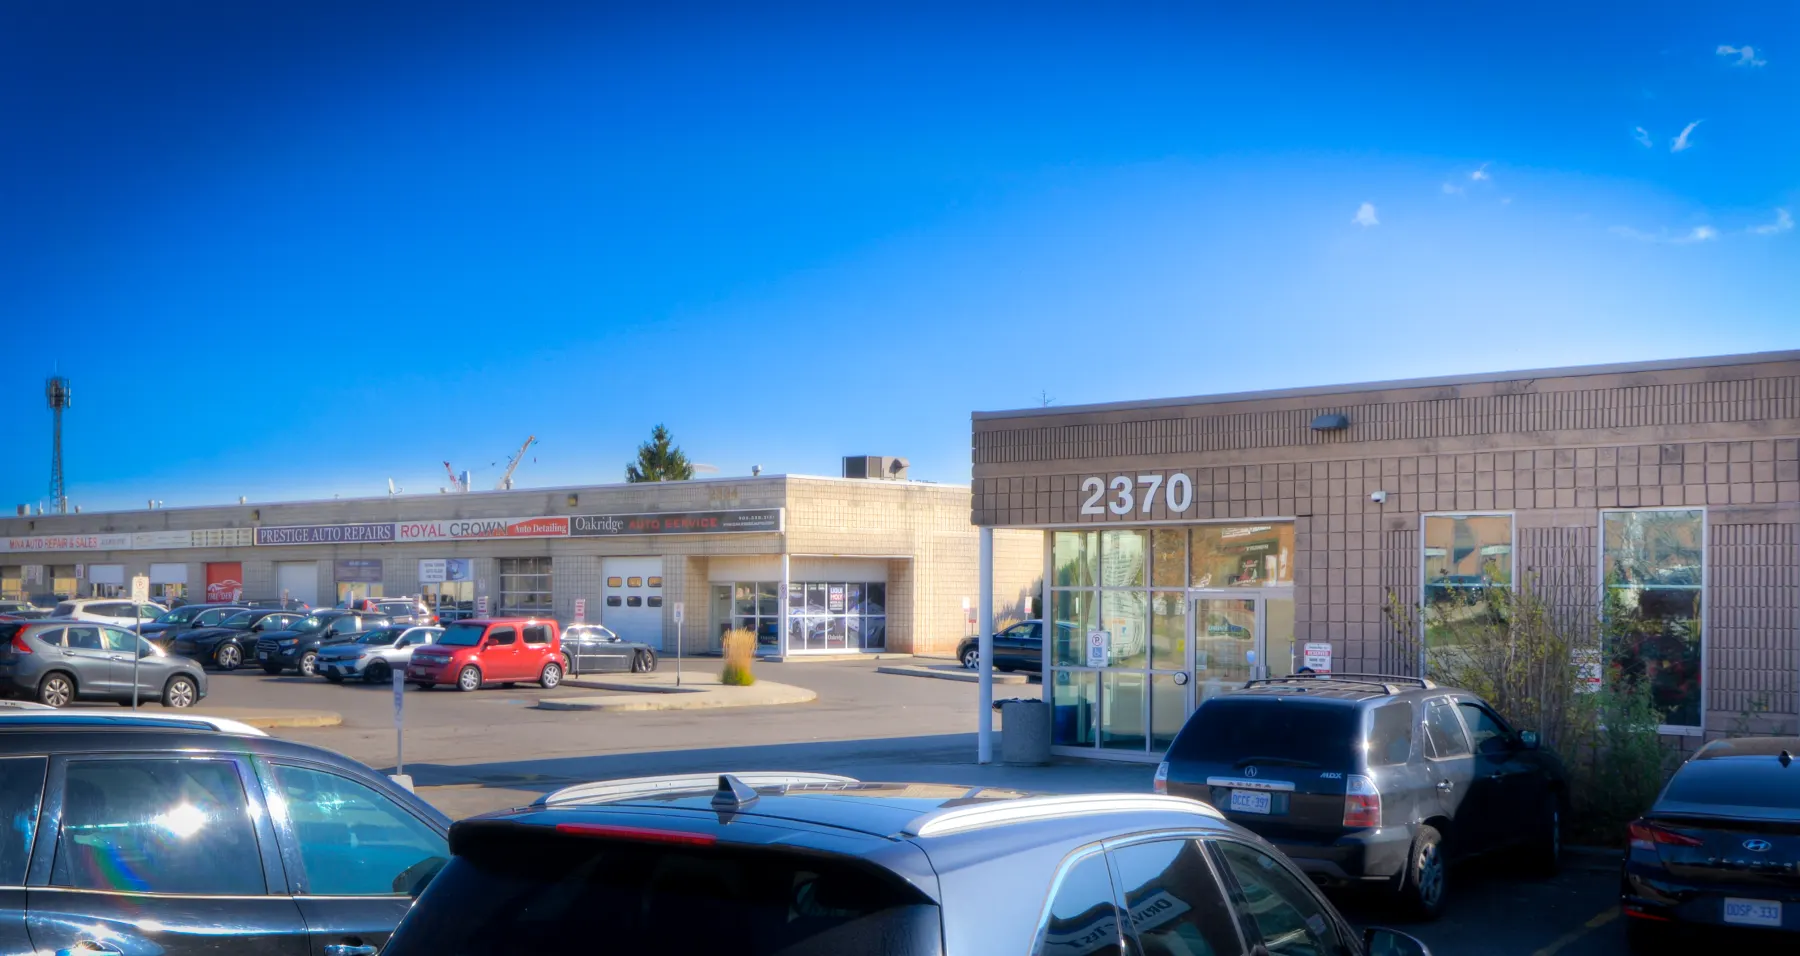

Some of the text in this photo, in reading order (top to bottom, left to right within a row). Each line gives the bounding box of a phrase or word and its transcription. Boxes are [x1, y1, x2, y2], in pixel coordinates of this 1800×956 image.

[1081, 473, 1193, 515] 2370
[400, 521, 508, 538] ROYAL CROWN
[514, 522, 567, 535] Auto Detailing
[575, 516, 624, 534] Oakridge
[629, 518, 660, 530] AUTO
[665, 517, 718, 529] SERVICE
[260, 527, 310, 543] PRESTIGE
[311, 526, 341, 542] AUTO
[344, 525, 391, 541] REPAIRS
[10, 539, 24, 549] MINA
[26, 538, 43, 549] AUTO
[44, 538, 67, 548] REPAIR
[76, 537, 97, 548] SALES
[1232, 794, 1269, 808] DCCE-397
